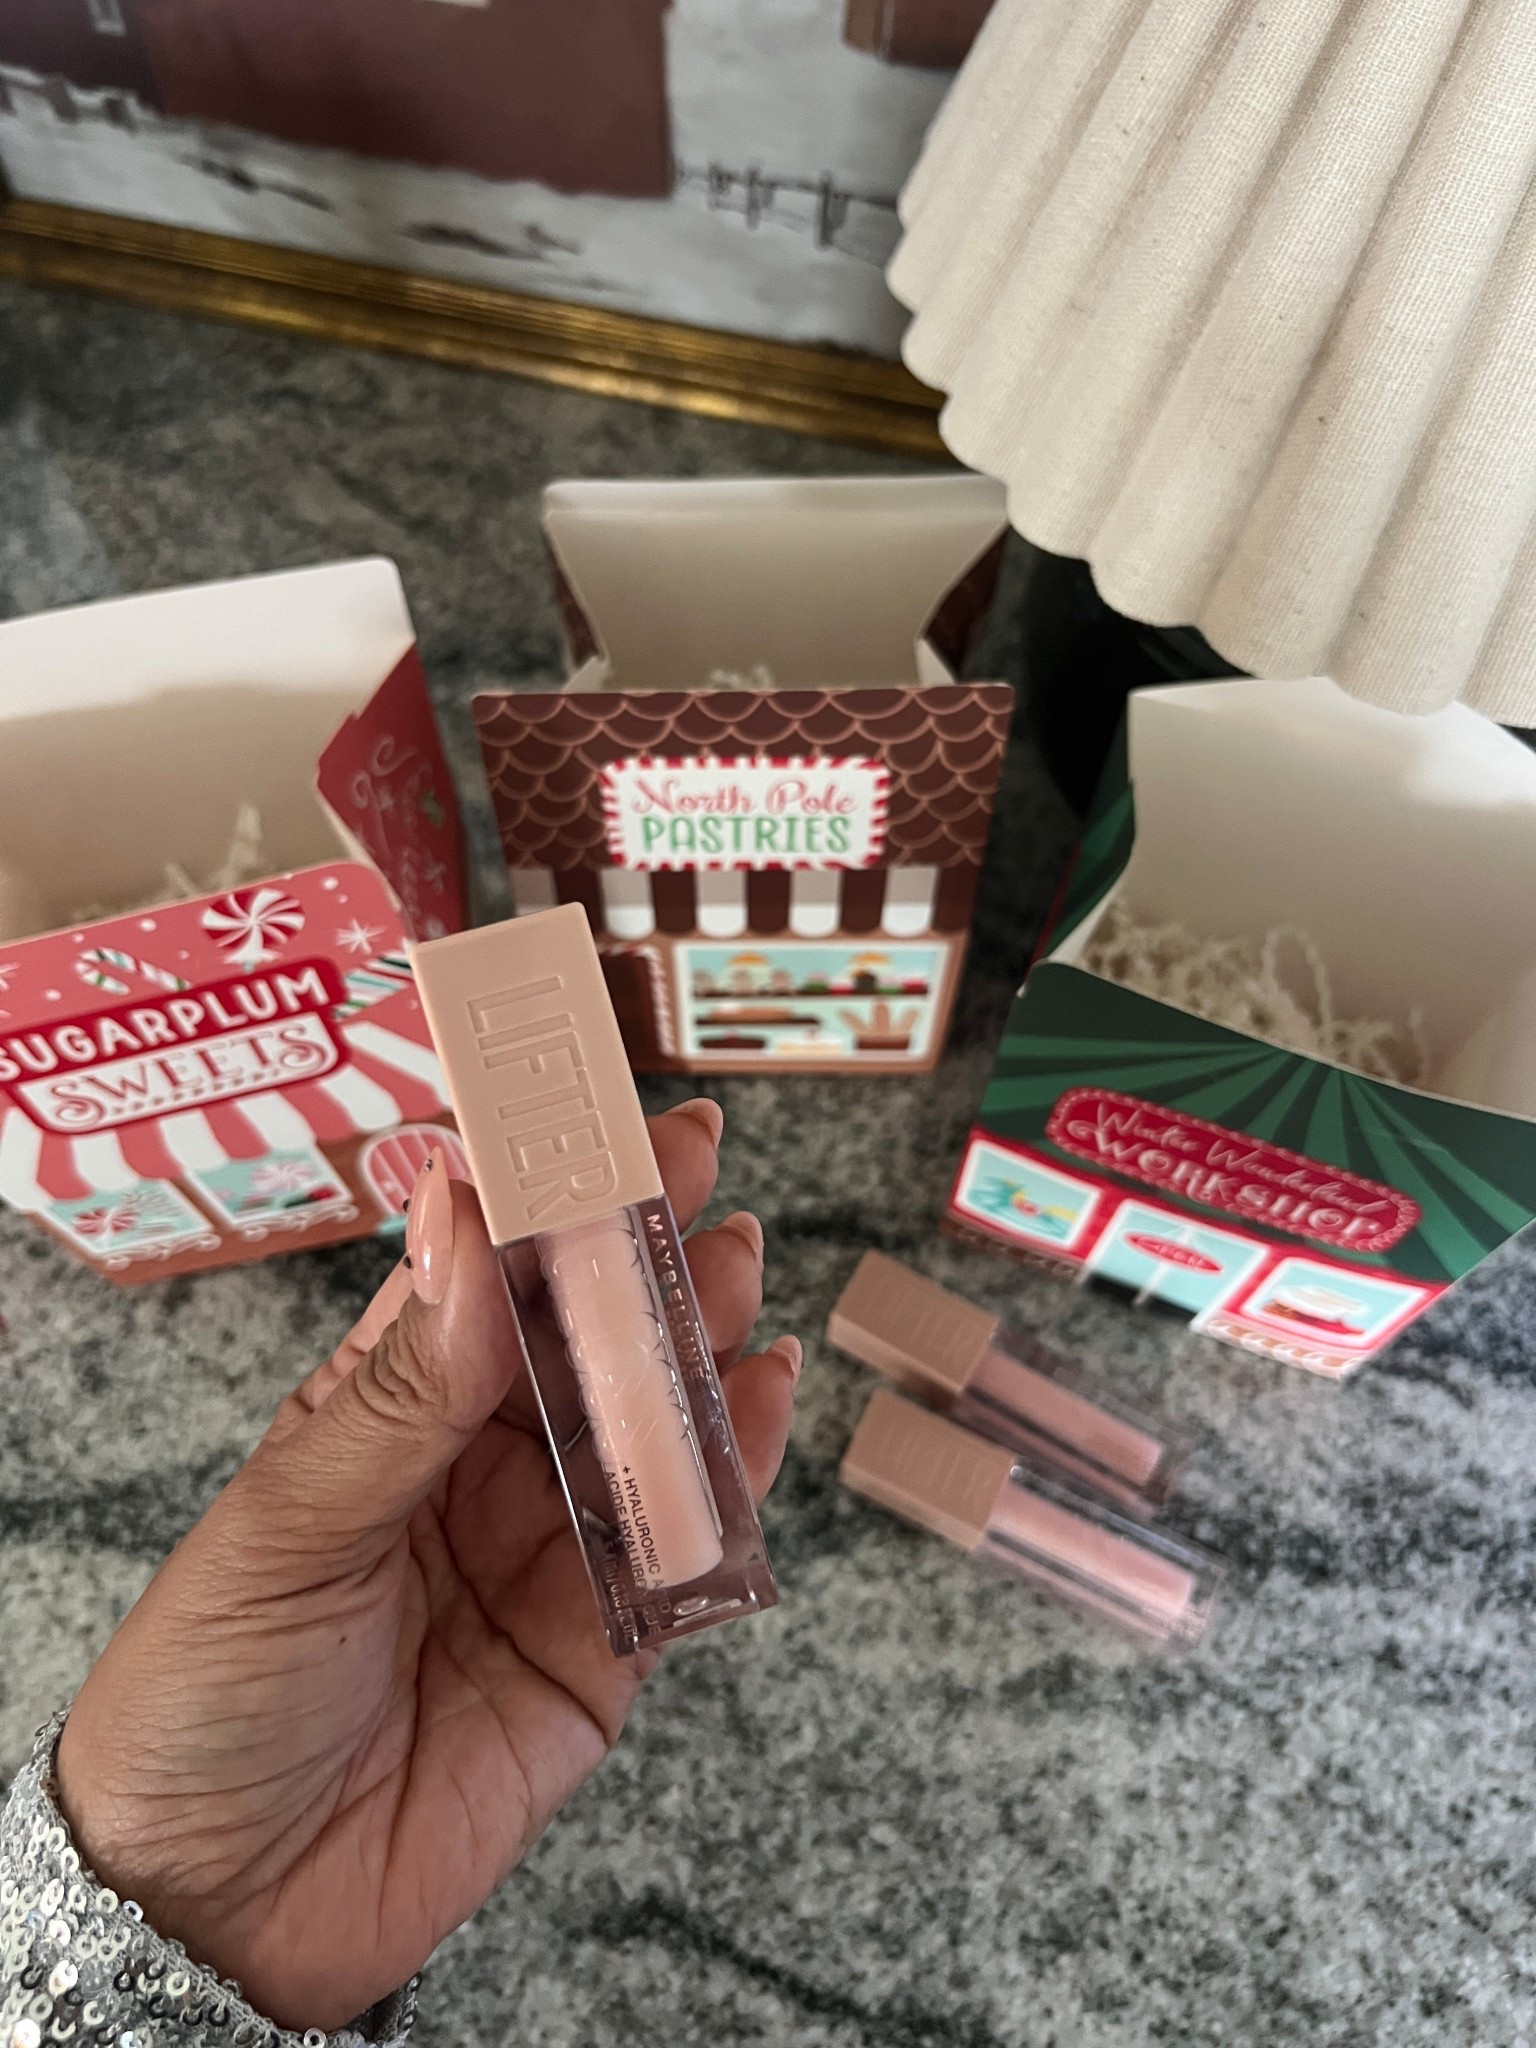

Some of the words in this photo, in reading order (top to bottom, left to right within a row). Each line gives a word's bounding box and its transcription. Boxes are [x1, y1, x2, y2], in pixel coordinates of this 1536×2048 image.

[631, 777, 756, 814] North
[765, 776, 858, 815] Pole
[641, 815, 851, 854] PASTRIES
[51, 1023, 330, 1127] SWEETS
[466, 975, 619, 1221] LIFTER
[647, 1213, 705, 1380] MAYBELLINE
[604, 1470, 628, 1517] ACIDE
[618, 1518, 663, 1635] HYALURONQUE
[623, 1477, 662, 1575] HYALURONIC
